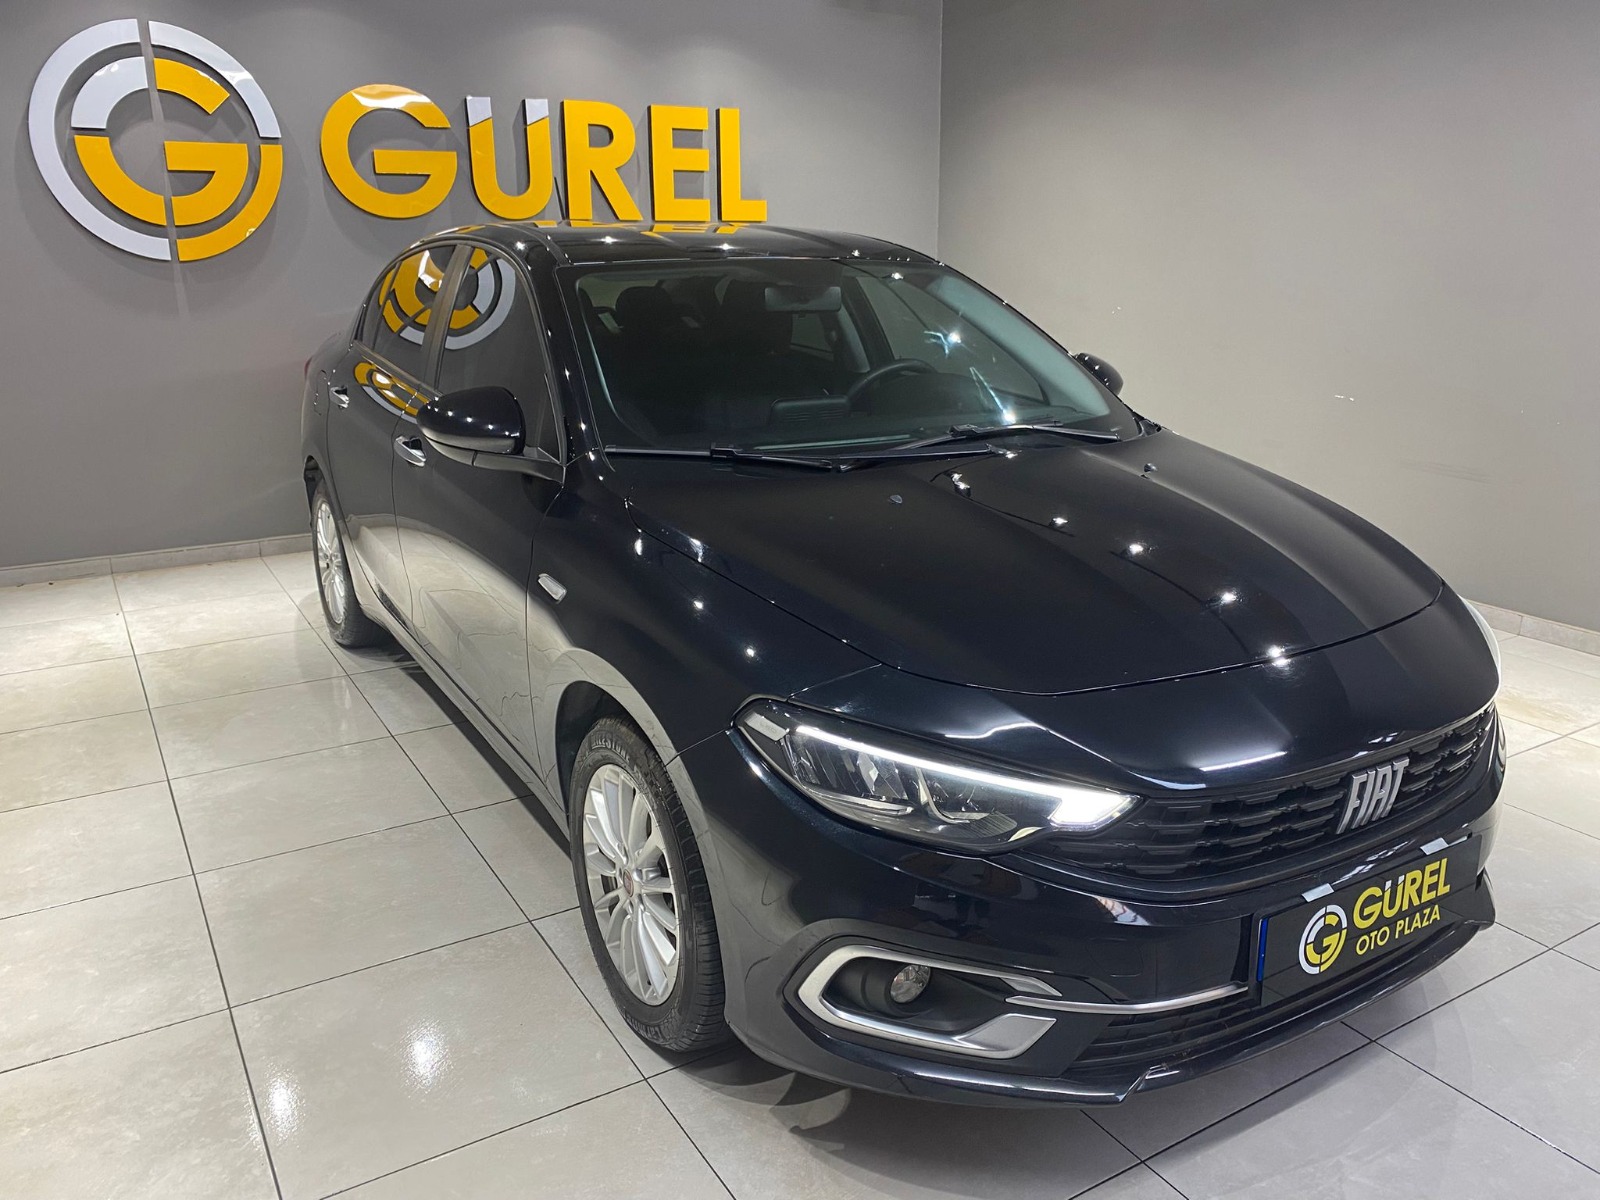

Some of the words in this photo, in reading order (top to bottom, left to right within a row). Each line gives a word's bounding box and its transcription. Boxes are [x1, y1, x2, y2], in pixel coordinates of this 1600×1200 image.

[1336, 757, 1410, 834] FIAT
[1356, 926, 1390, 955] OTO
[1395, 904, 1441, 939] PLAZA
